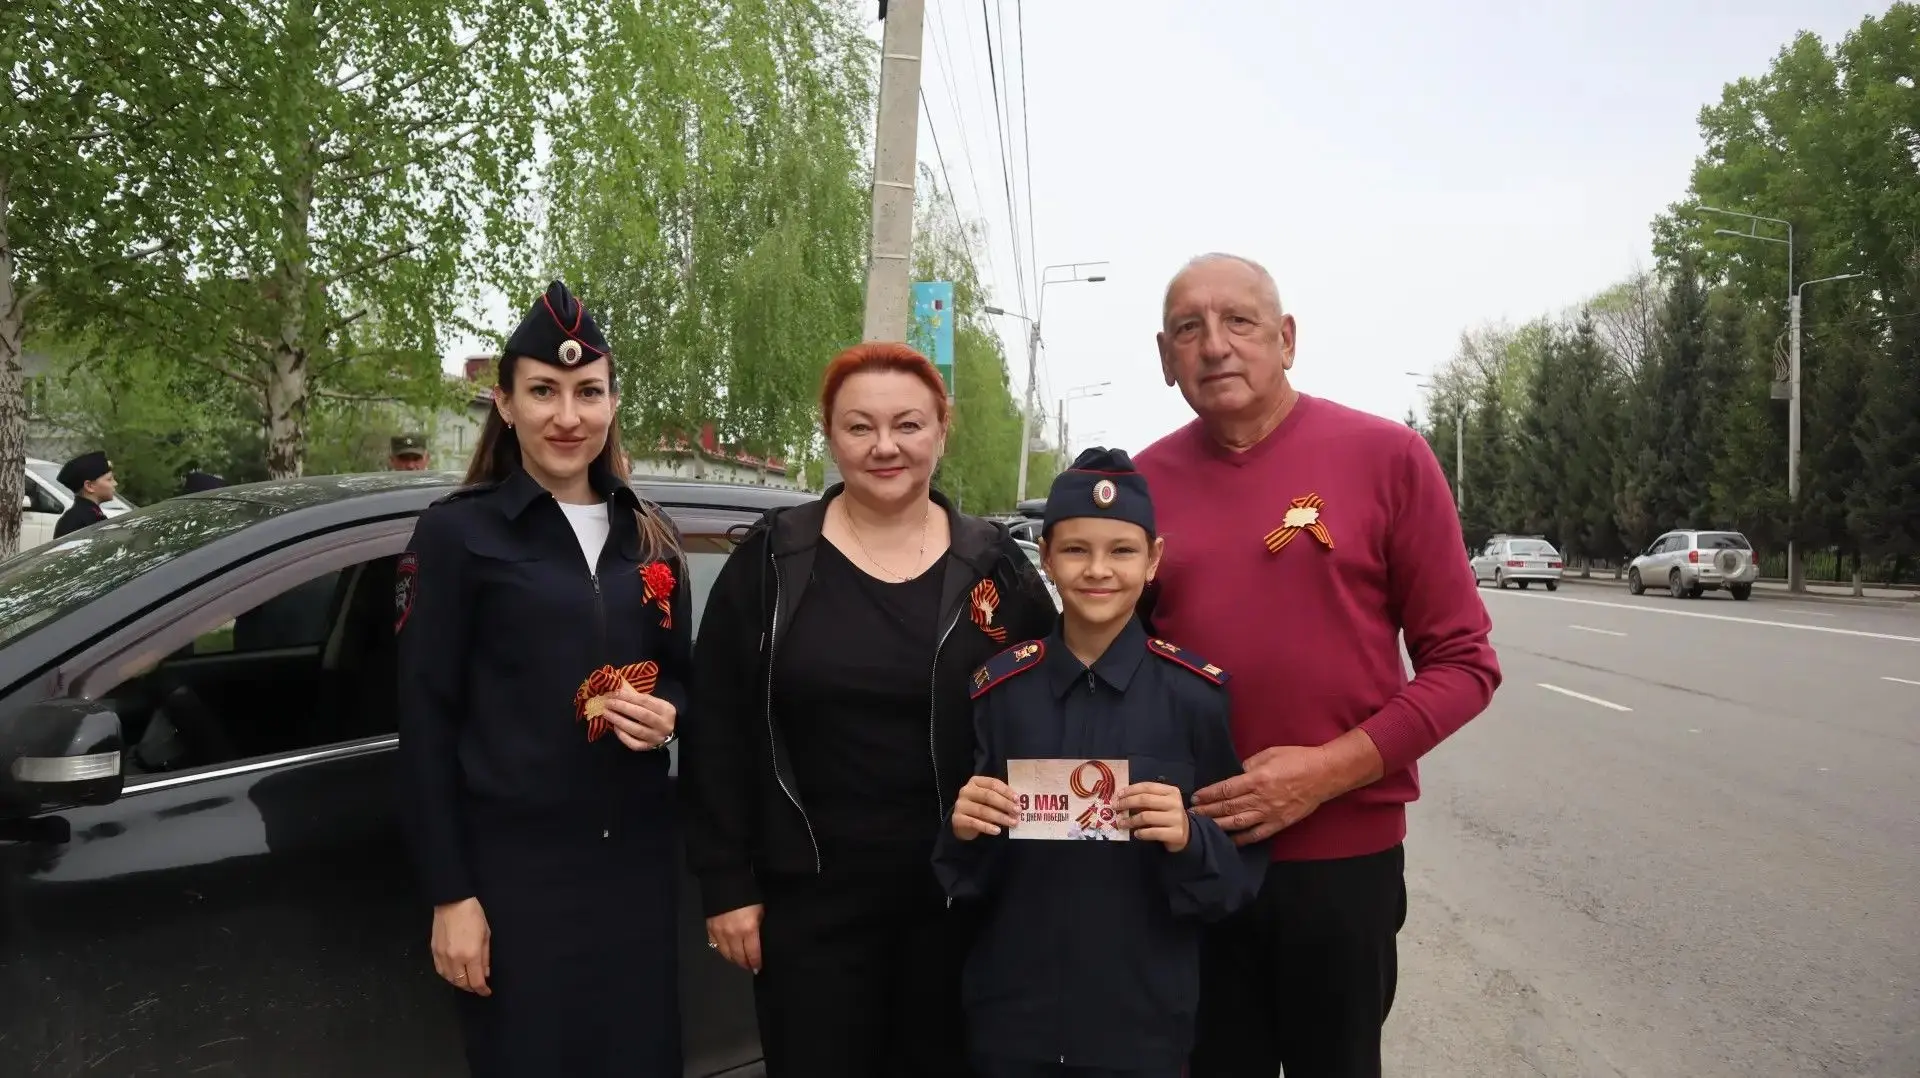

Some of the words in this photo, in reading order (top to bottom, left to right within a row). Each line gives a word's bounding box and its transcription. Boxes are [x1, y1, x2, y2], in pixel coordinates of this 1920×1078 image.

[1019, 794, 1029, 811] 9
[1034, 794, 1069, 811] МАЯ
[1020, 812, 1025, 822] С
